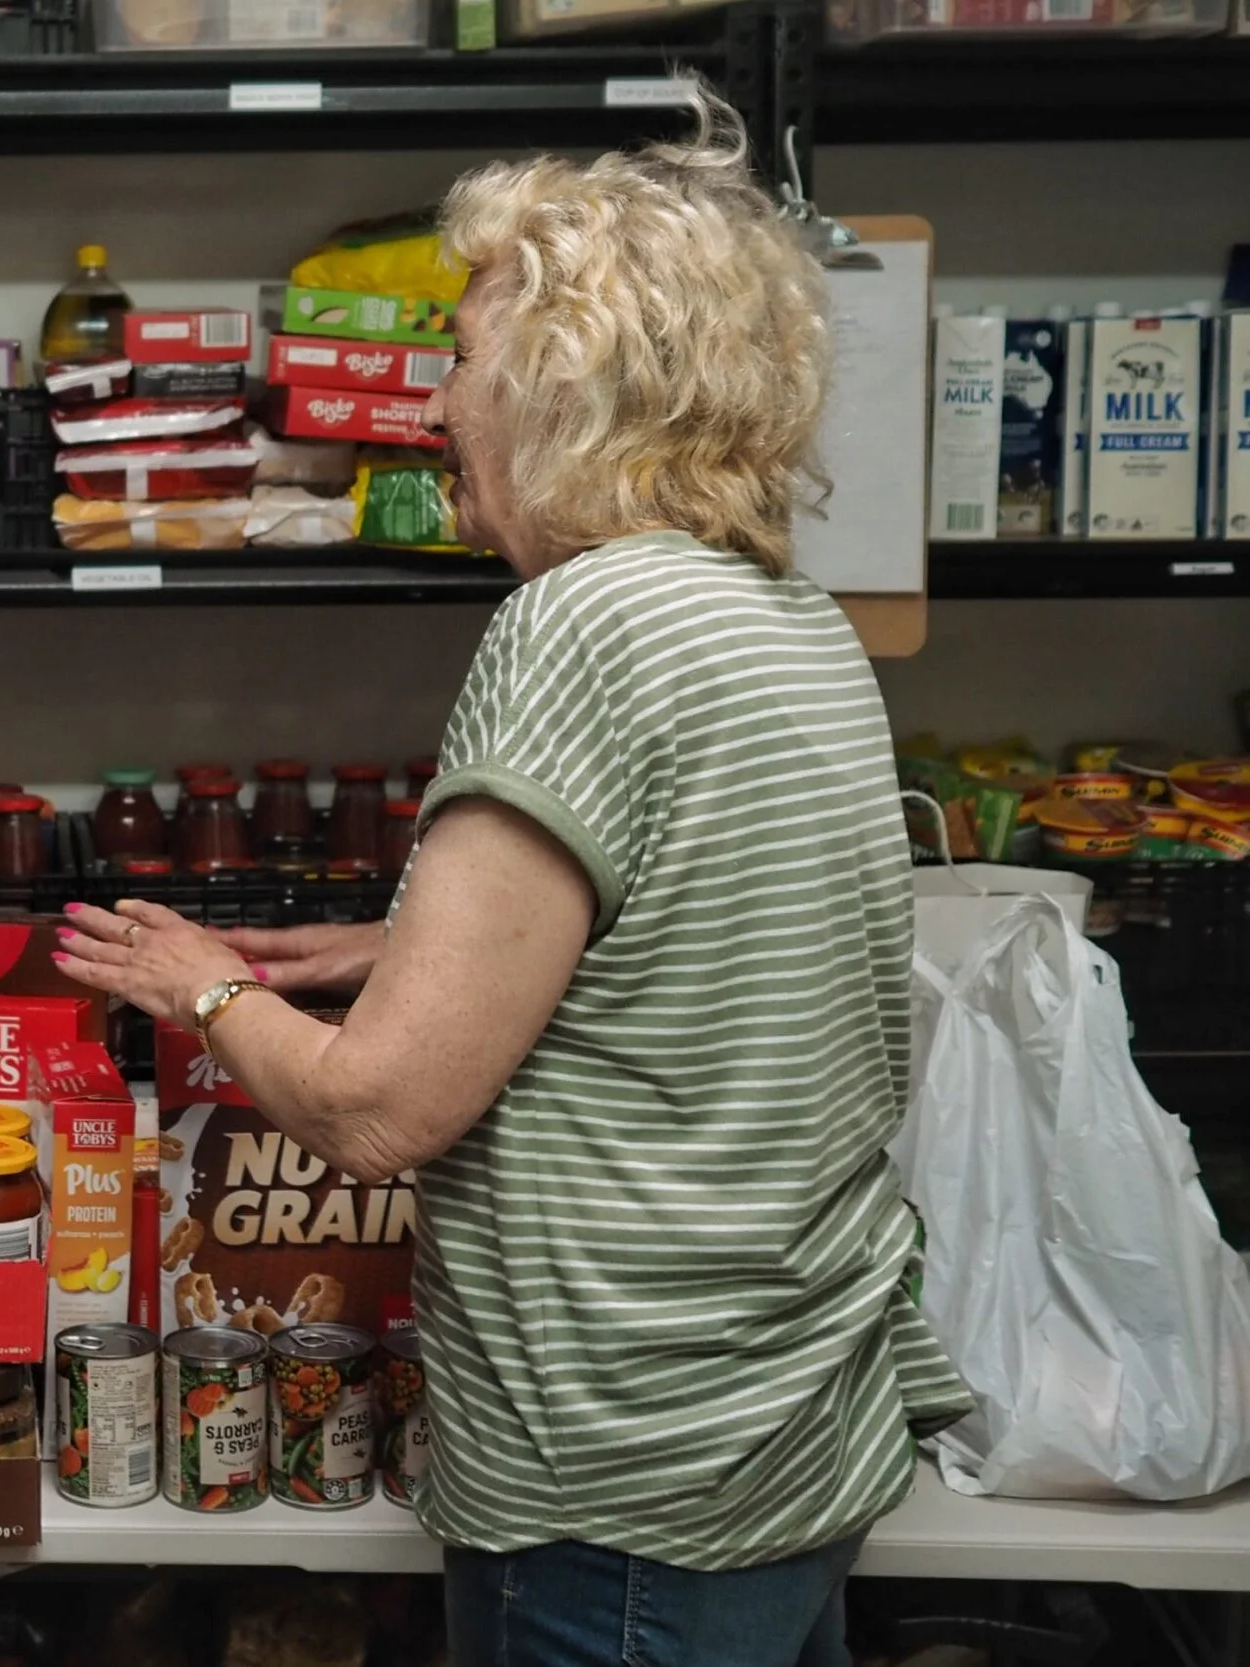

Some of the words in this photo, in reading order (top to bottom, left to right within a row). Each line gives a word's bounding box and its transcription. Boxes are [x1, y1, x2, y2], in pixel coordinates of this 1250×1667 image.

[945, 387, 993, 403] MILK
[1106, 392, 1183, 421] MILK
[1107, 437, 1135, 448] FULL
[1139, 437, 1182, 448] CREAM
[72, 1121, 116, 1134] UNCLE
[72, 1133, 117, 1146] TOBYS
[64, 1163, 122, 1195] Plus
[67, 1207, 116, 1223] PROTEIN
[206, 1417, 263, 1440] CARROTS
[339, 1411, 368, 1430] PEAS
[228, 1435, 259, 1454] PEAS
